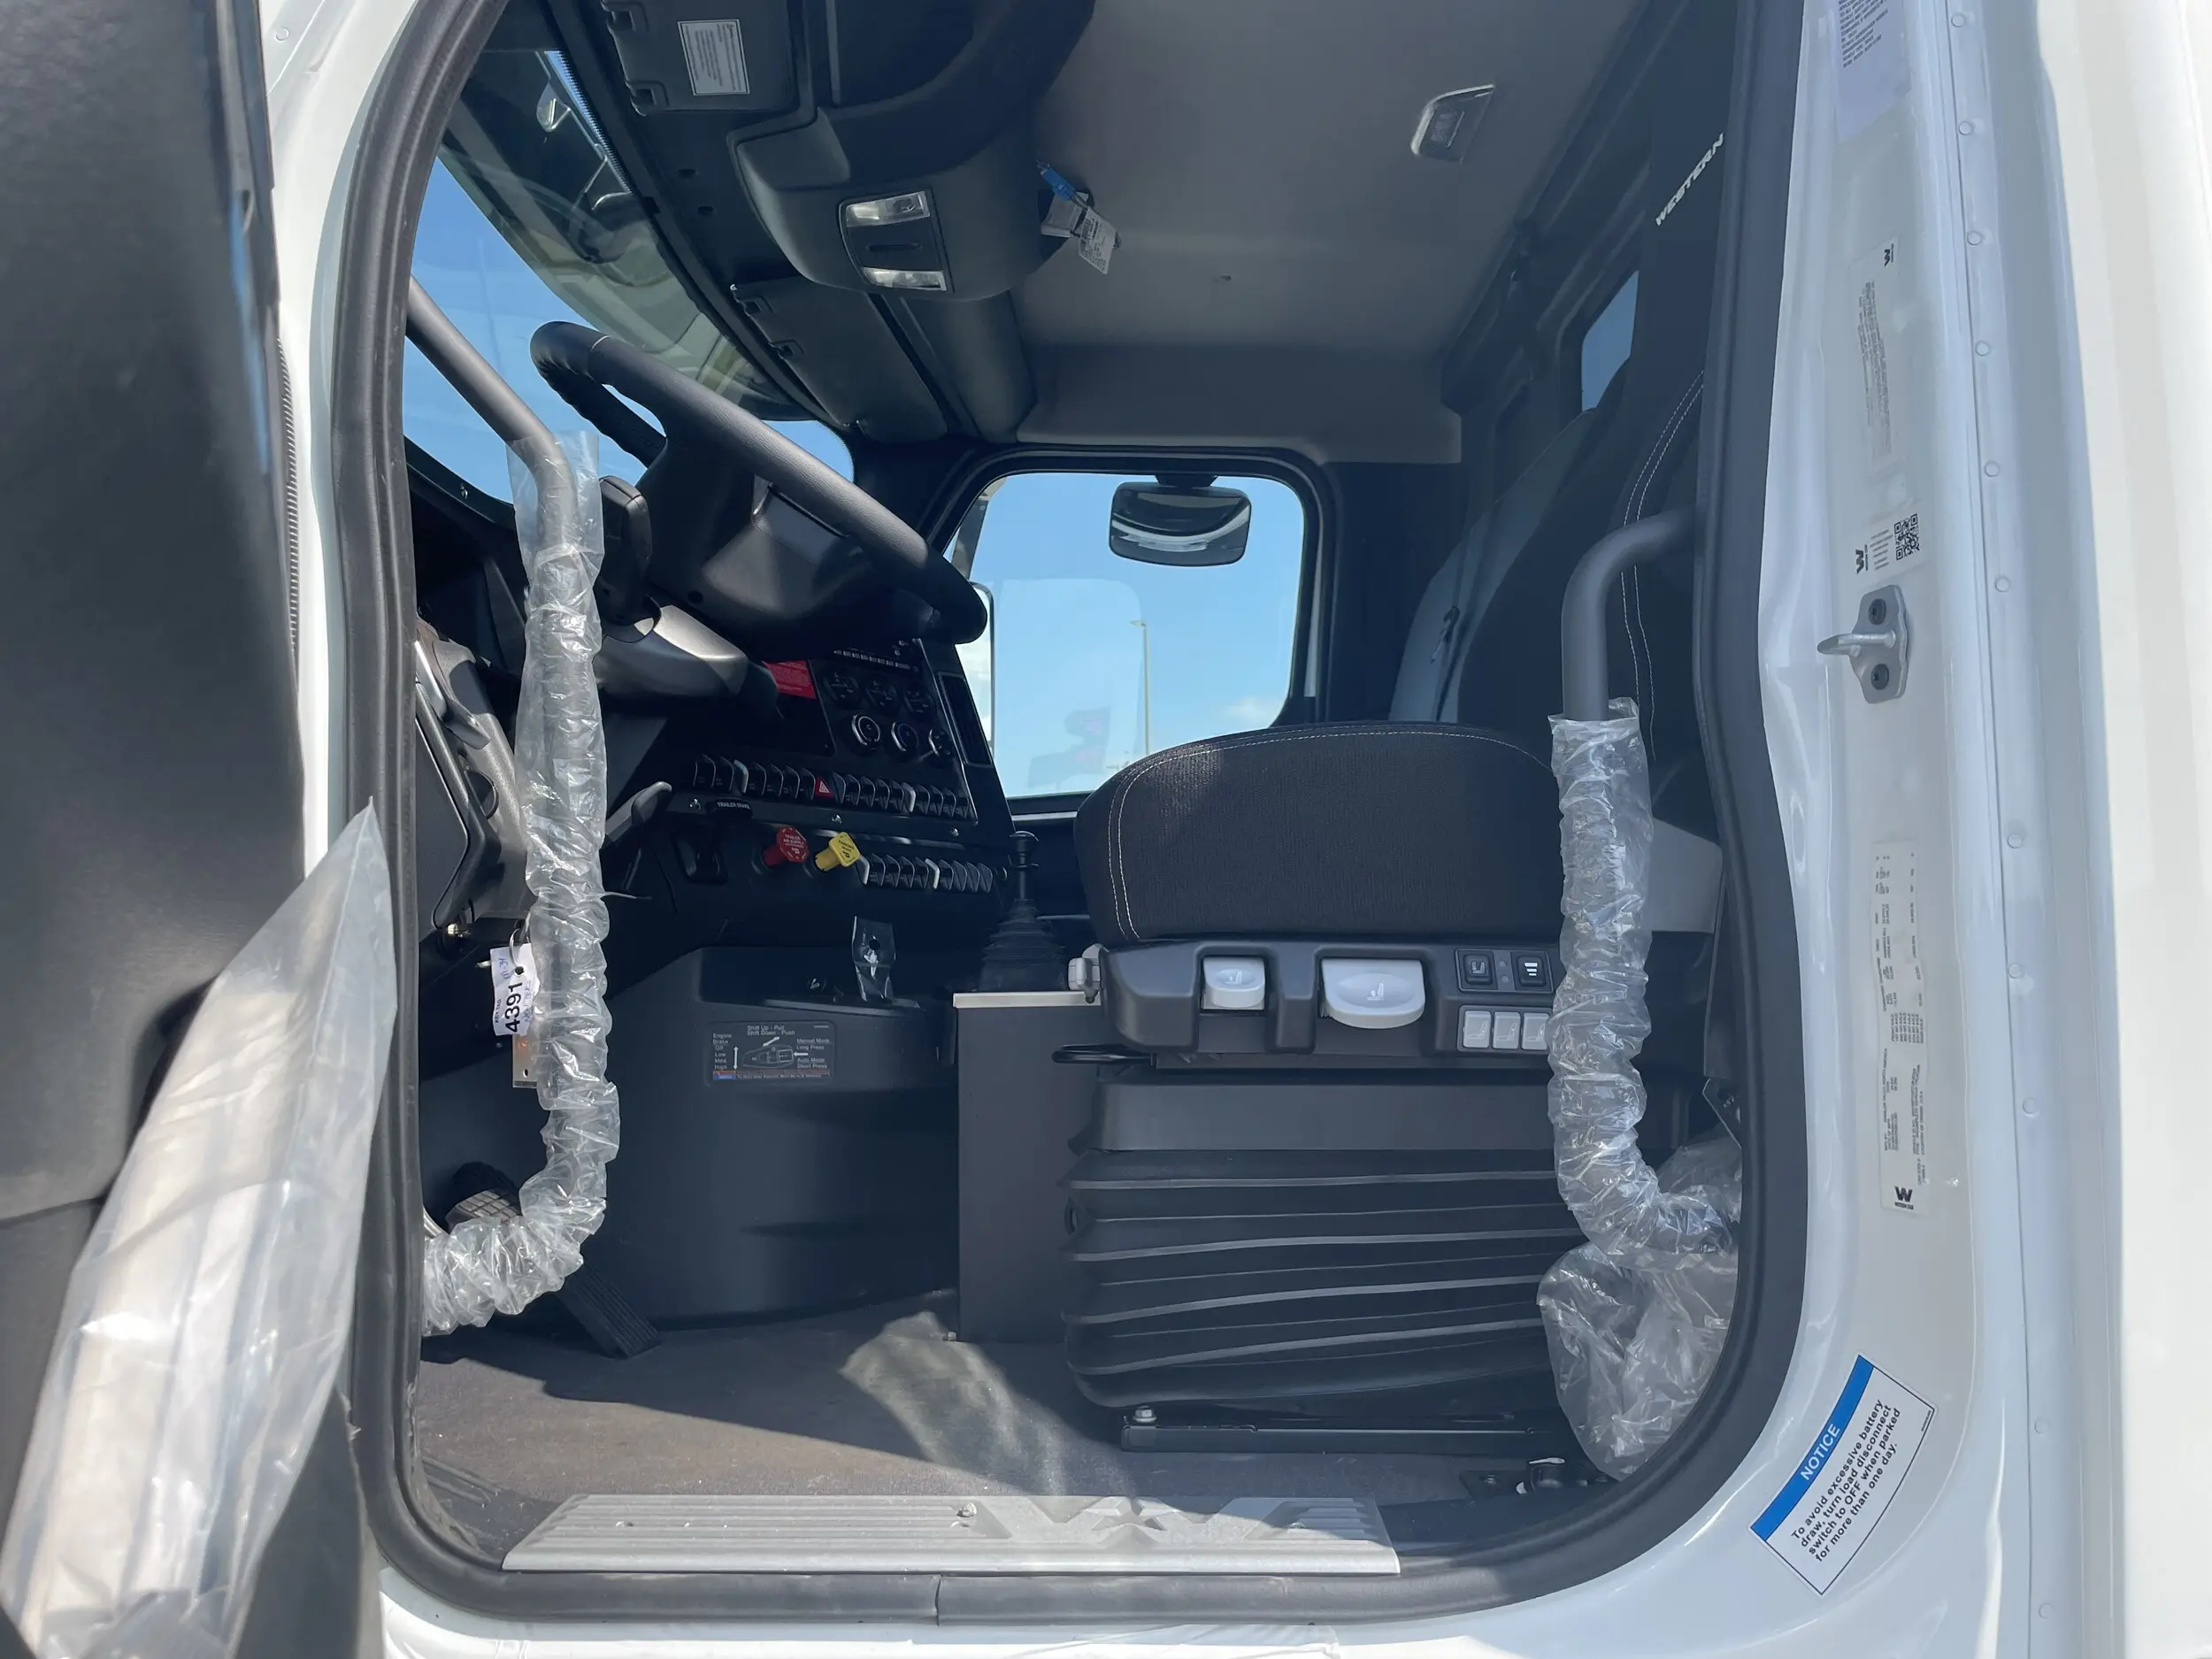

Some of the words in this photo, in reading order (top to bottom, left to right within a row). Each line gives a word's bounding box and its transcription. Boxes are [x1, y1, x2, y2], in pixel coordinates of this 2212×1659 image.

[1655, 132, 1724, 226] WESTERN
[505, 982, 523, 1033] 4391
[1791, 1527, 1805, 1540] To
[1805, 1496, 1828, 1526] avoid
[1828, 1443, 1862, 1495] excessive
[1859, 1399, 1883, 1440] battery
[1801, 1424, 1839, 1480] NOTICE
[1801, 1520, 1825, 1548] draw,
[1824, 1496, 1841, 1517] turn
[1839, 1469, 1858, 1494] load
[1857, 1405, 1891, 1468] disconnect
[1809, 1521, 1836, 1555] switch
[1835, 1508, 1846, 1519] to
[1845, 1481, 1861, 1504] OFF
[1861, 1451, 1880, 1479] when
[1879, 1408, 1900, 1449] parked
[1816, 1548, 1830, 1562] for
[1831, 1517, 1851, 1545] more
[1850, 1491, 1870, 1516] than
[1869, 1468, 1883, 1488] one
[1882, 1444, 1897, 1465] day.
